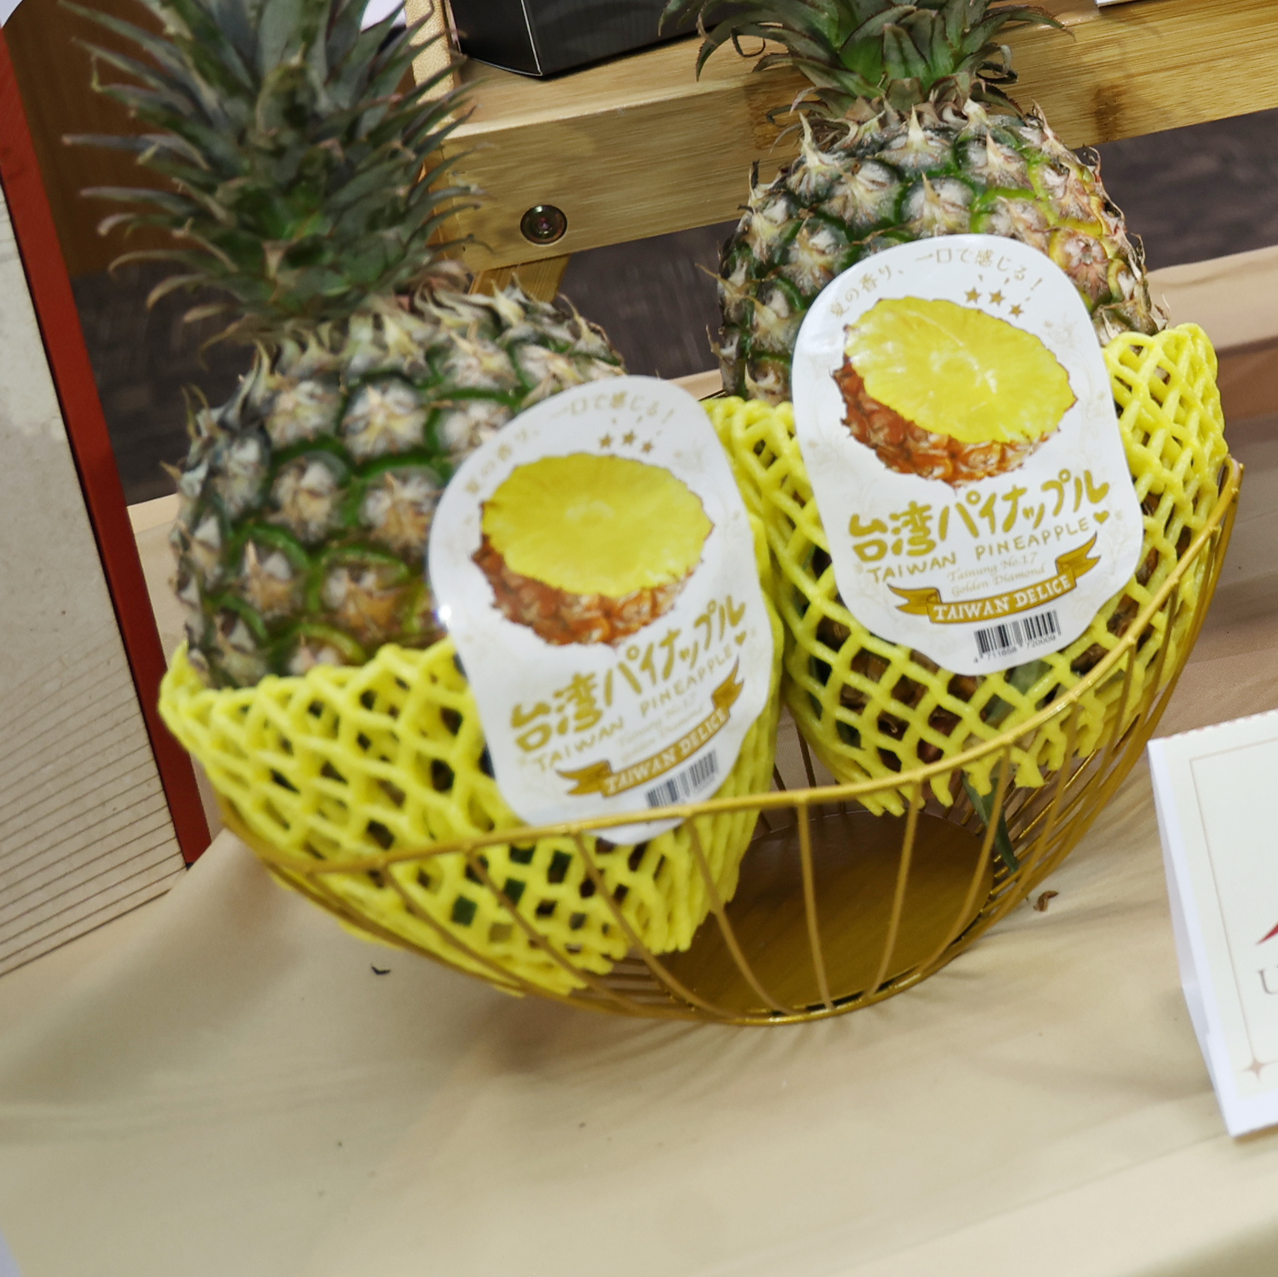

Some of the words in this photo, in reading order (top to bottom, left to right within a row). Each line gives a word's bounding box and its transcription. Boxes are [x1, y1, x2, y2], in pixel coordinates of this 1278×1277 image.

[849, 469, 1110, 562] 台湾パイナップル
[866, 552, 957, 584] TAIWAN
[975, 518, 1090, 560] PINEAPPLE
[933, 597, 1010, 621] TAIWAN
[1014, 573, 1072, 608] DELICE
[510, 595, 746, 753] 台湾パイナップル
[534, 716, 625, 774] TAIWAN
[640, 644, 733, 719] PINEAPPLE
[604, 751, 679, 794] TAIWAN
